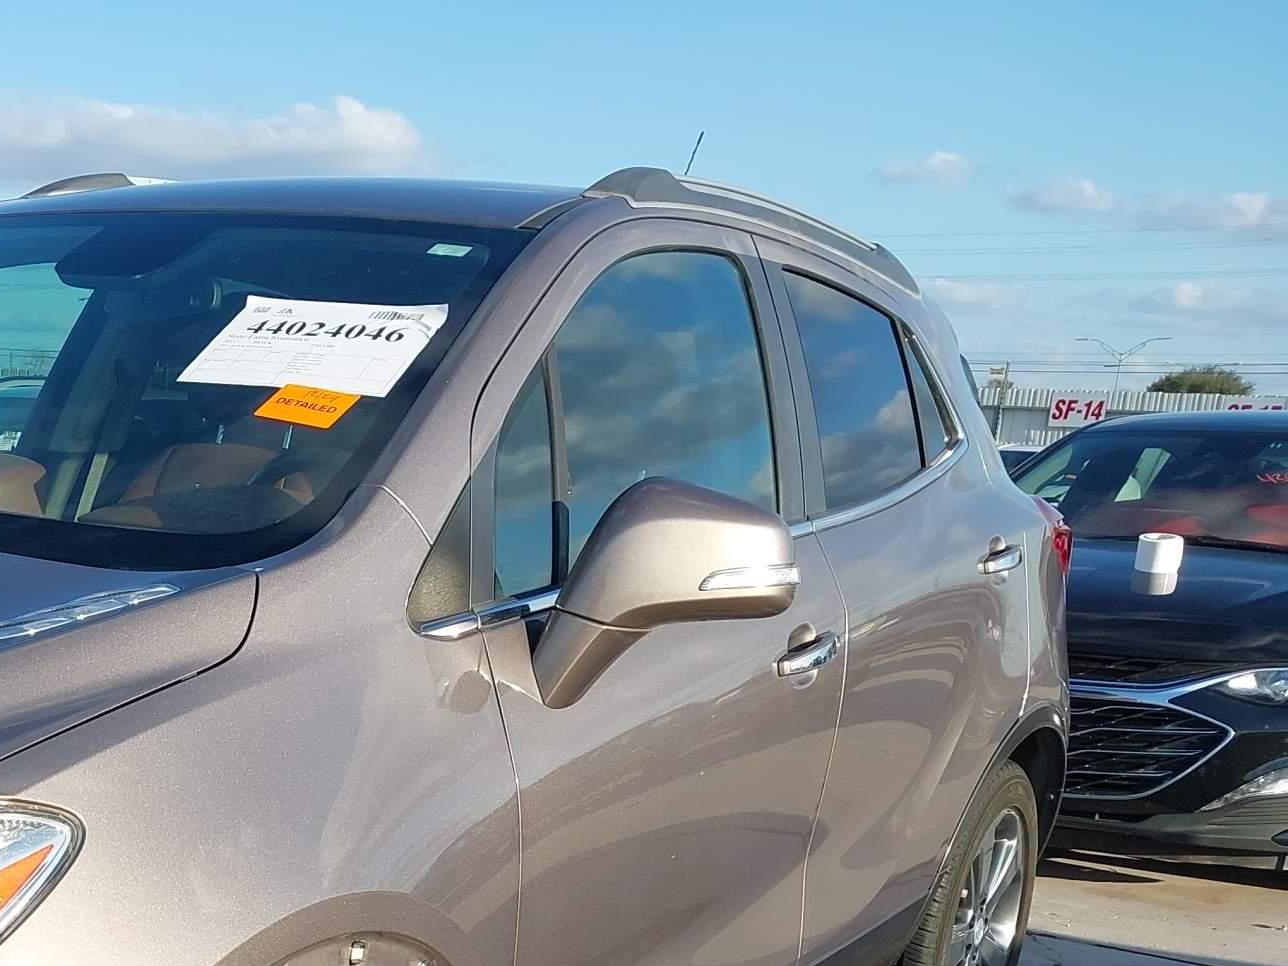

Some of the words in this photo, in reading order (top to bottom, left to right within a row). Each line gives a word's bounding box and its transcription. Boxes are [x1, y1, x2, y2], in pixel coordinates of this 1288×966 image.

[246, 319, 411, 343] 44024046
[275, 397, 337, 414] DETAILED
[1051, 399, 1105, 420] SF-14
